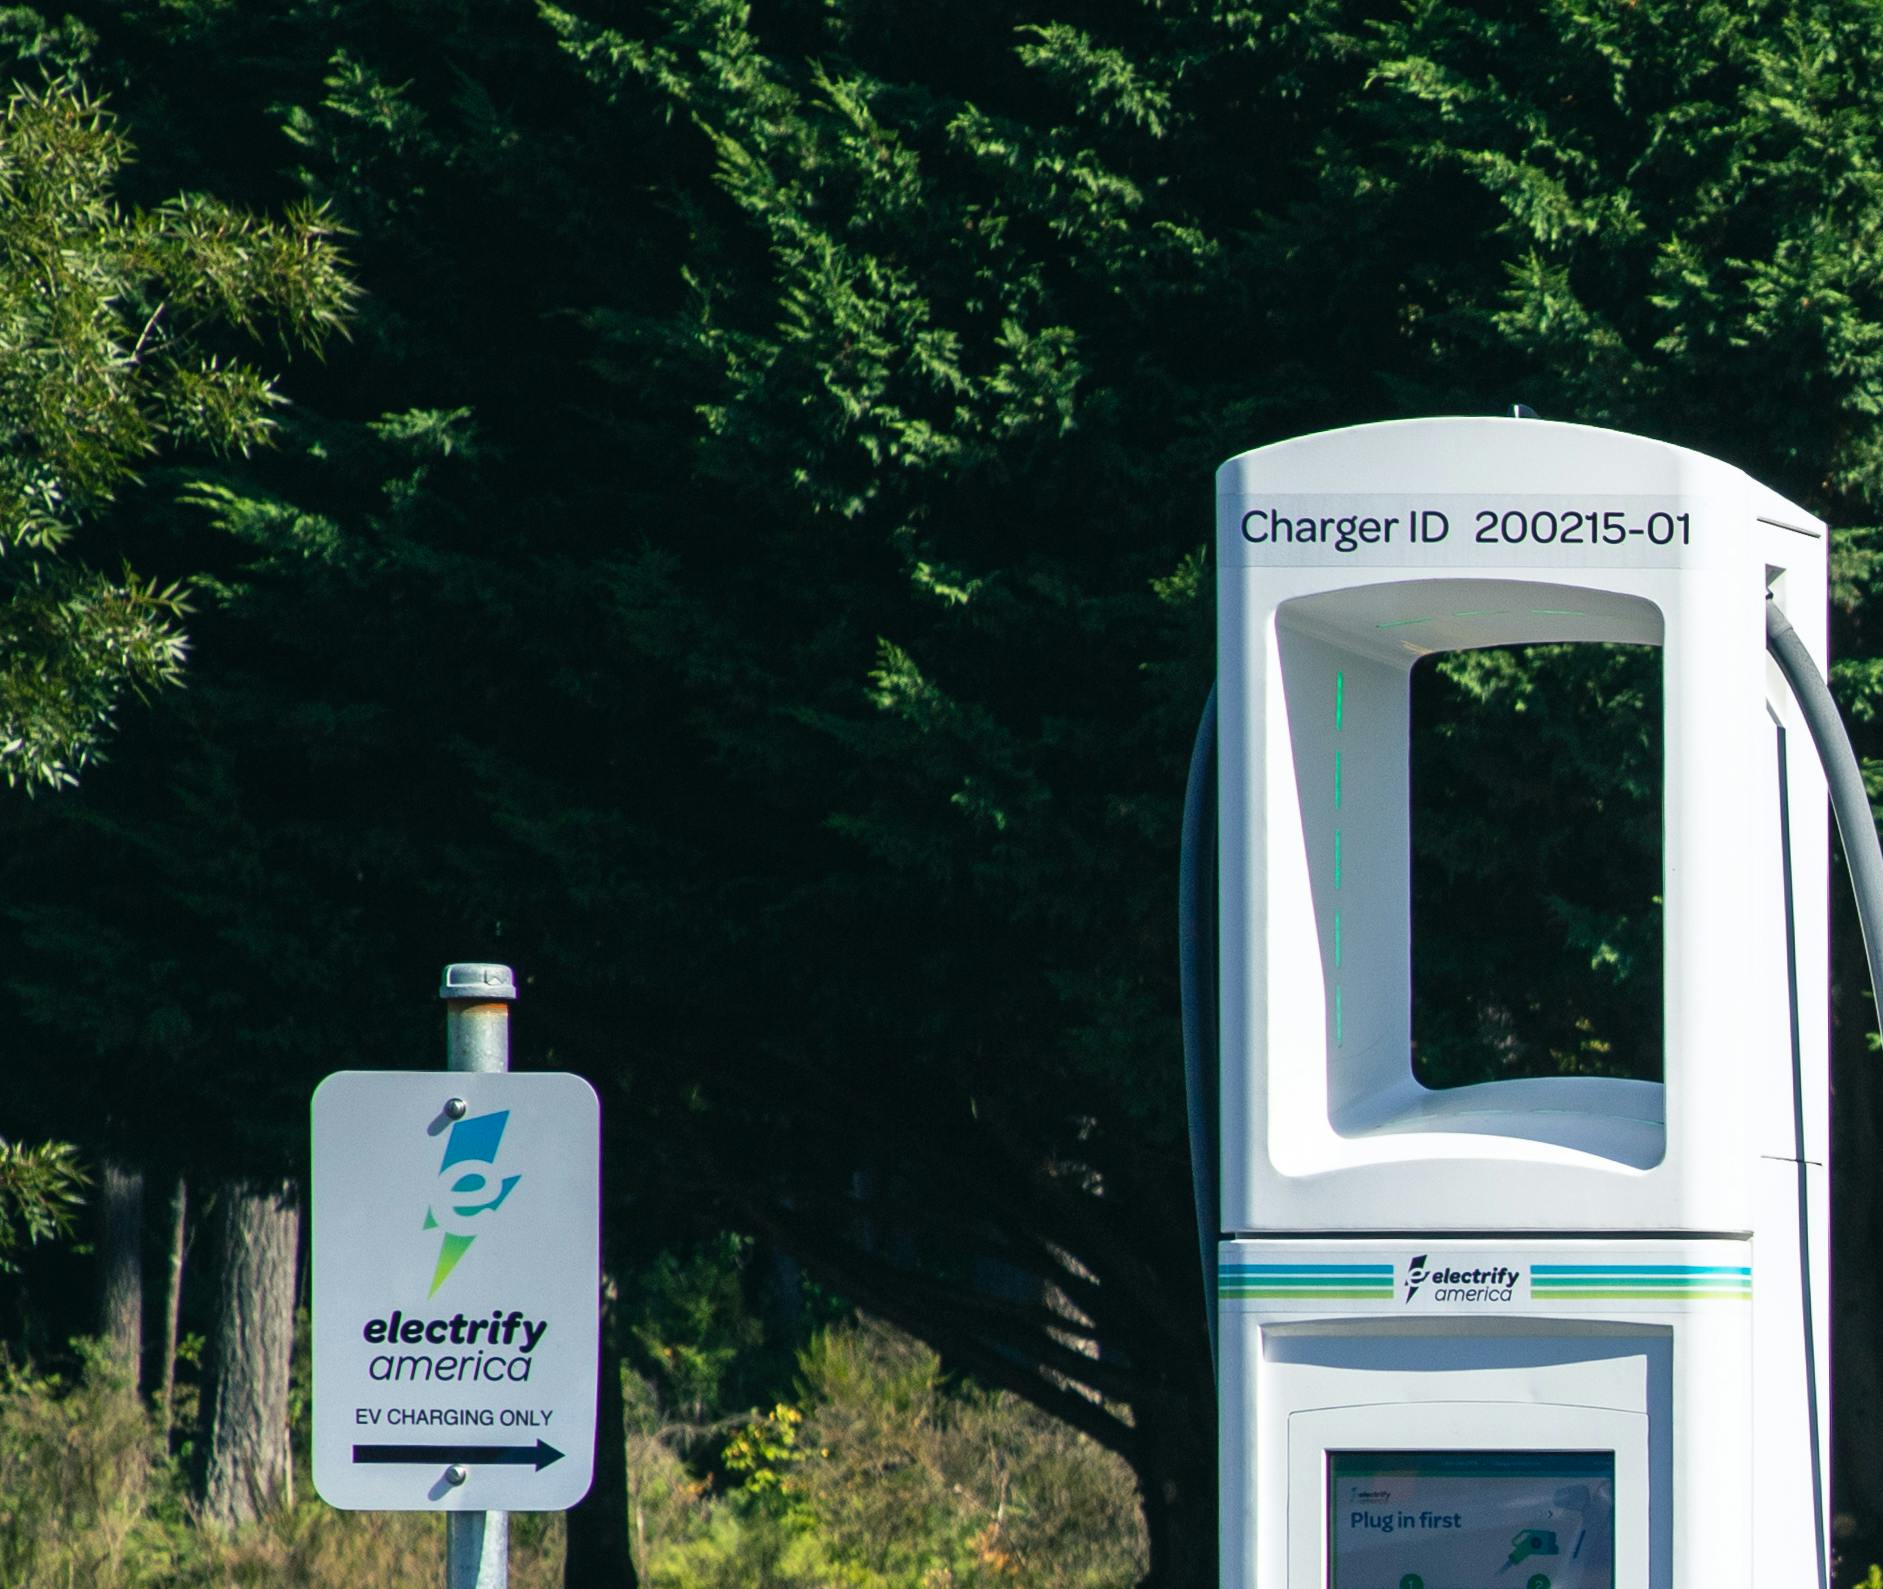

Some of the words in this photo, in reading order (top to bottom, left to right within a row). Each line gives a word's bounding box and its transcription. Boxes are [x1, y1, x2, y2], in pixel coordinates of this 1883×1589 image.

[1241, 508, 1398, 552] Charger
[1410, 510, 1449, 543] ID
[1474, 510, 1692, 546] 200215-01
[1432, 1266, 1520, 1288] electrify
[1434, 1286, 1512, 1302] america
[363, 1310, 548, 1354] electrify
[368, 1348, 532, 1382] america
[355, 1408, 382, 1425] EV
[387, 1408, 494, 1426] CHARGING
[499, 1408, 554, 1427] ONLY
[1350, 1510, 1394, 1532] Plug
[1398, 1510, 1416, 1528] in
[1418, 1510, 1462, 1528] first
